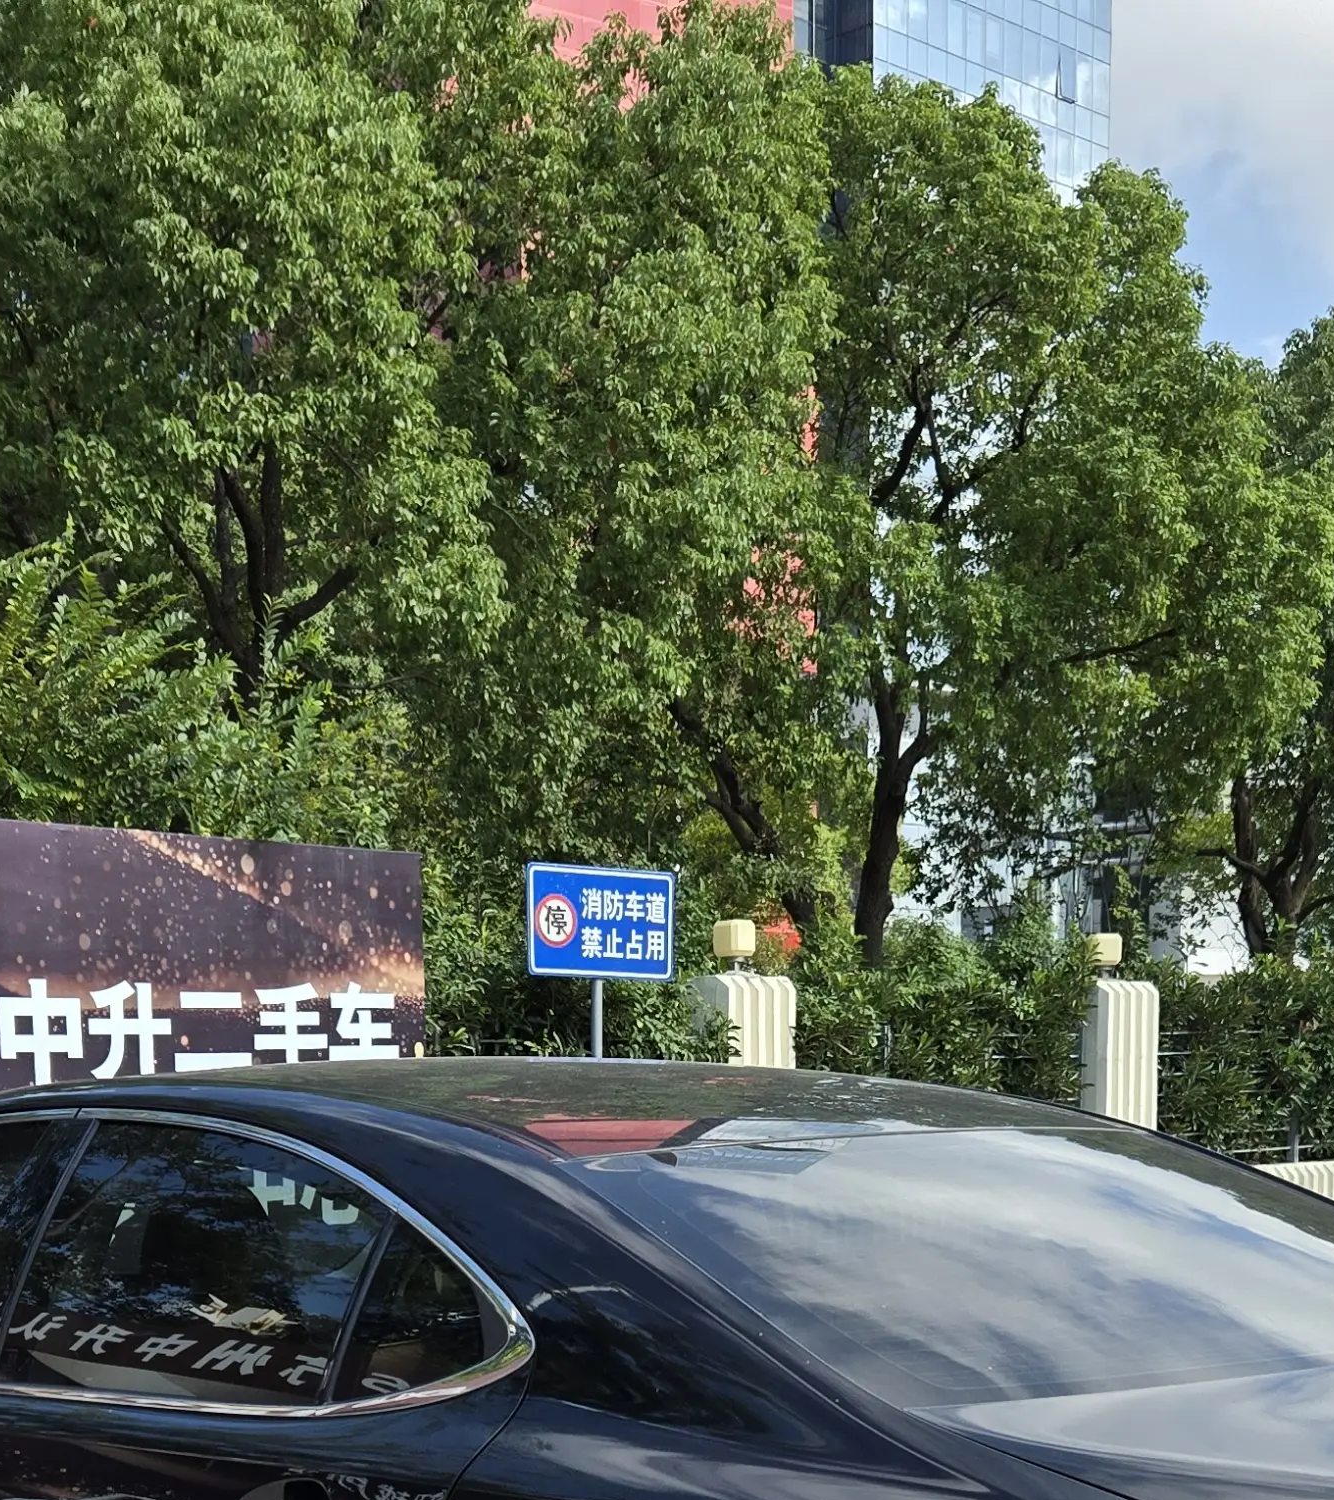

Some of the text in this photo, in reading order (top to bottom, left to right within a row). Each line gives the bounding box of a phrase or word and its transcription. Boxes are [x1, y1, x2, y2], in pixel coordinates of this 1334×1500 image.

[581, 887, 666, 924] 消防车道
[581, 926, 665, 961] 禁止占用
